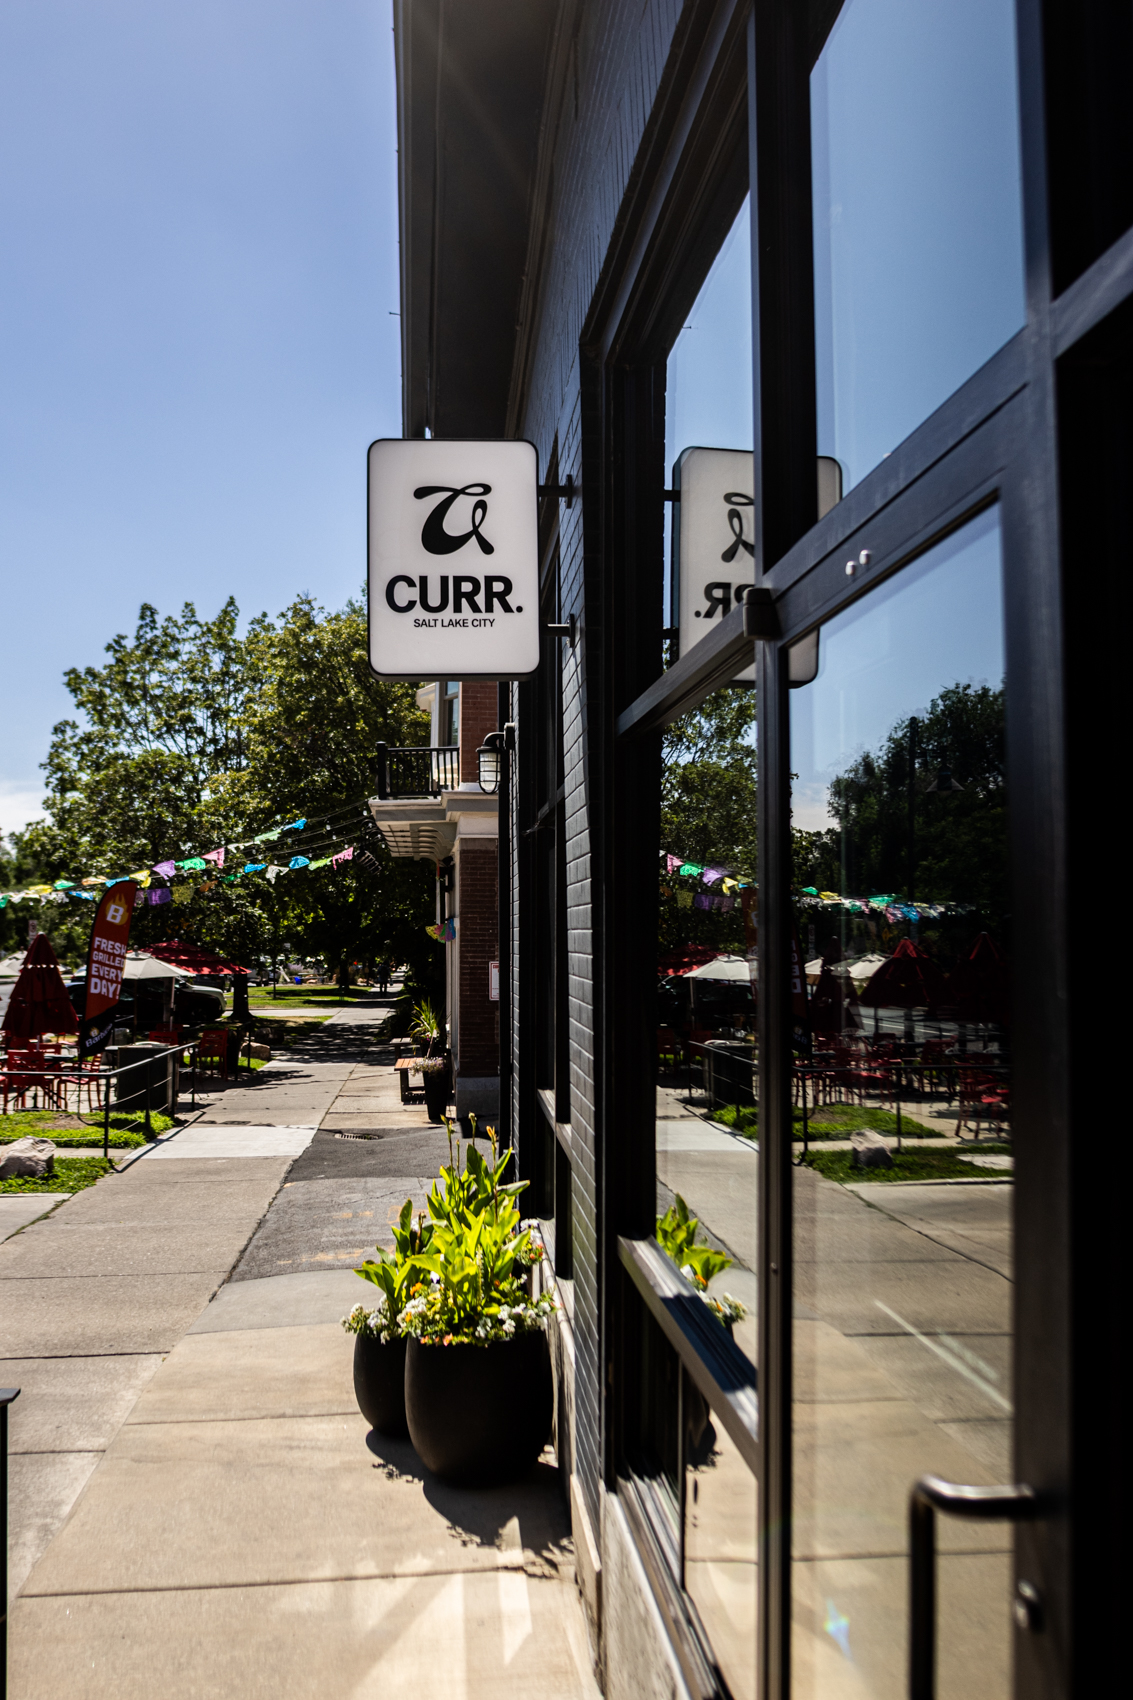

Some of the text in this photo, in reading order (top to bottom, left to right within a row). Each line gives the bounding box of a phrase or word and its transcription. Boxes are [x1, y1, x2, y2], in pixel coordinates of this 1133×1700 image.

[385, 575, 523, 614] CURR.
[413, 618, 496, 628] SALT LAKE CITY
[106, 903, 124, 924] B
[94, 936, 127, 956] FRESH
[92, 951, 125, 968] GRILLED
[91, 963, 123, 982] EVERY
[90, 977, 121, 1000] DAY!
